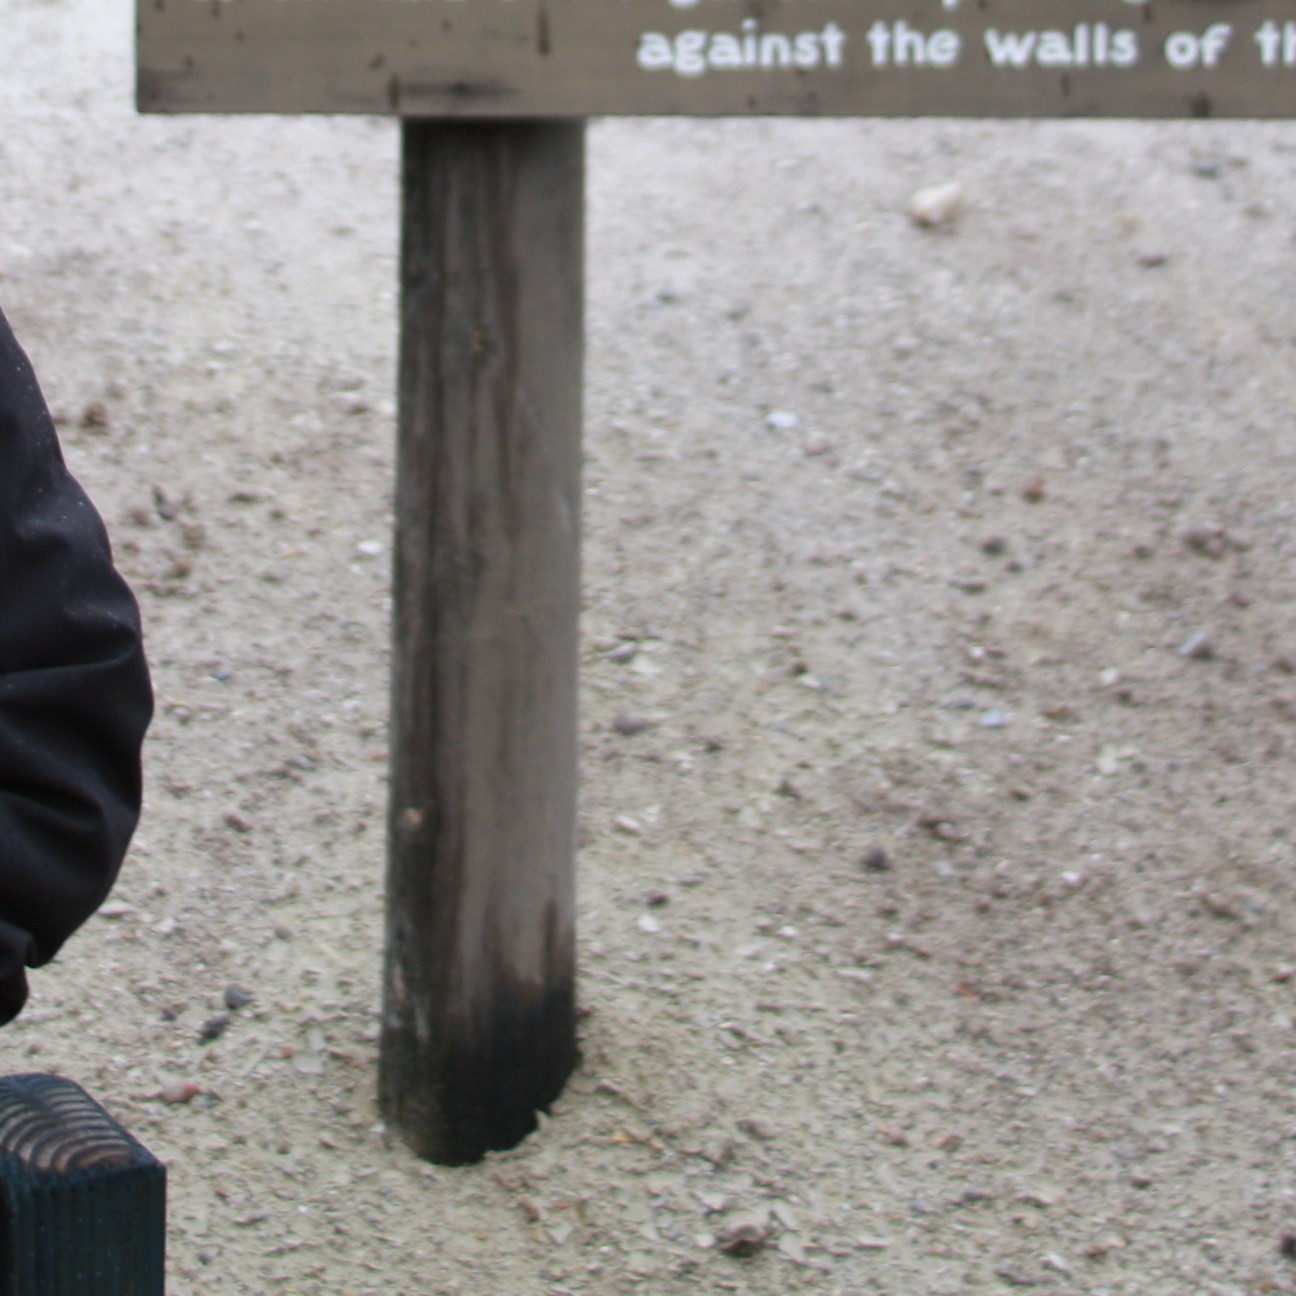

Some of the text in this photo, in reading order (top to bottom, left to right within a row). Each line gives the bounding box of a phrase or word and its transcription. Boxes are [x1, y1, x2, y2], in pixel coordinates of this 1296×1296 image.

[636, 18, 846, 78] against
[865, 19, 962, 68] the
[983, 22, 1139, 68] walls
[1164, 22, 1232, 69] of
